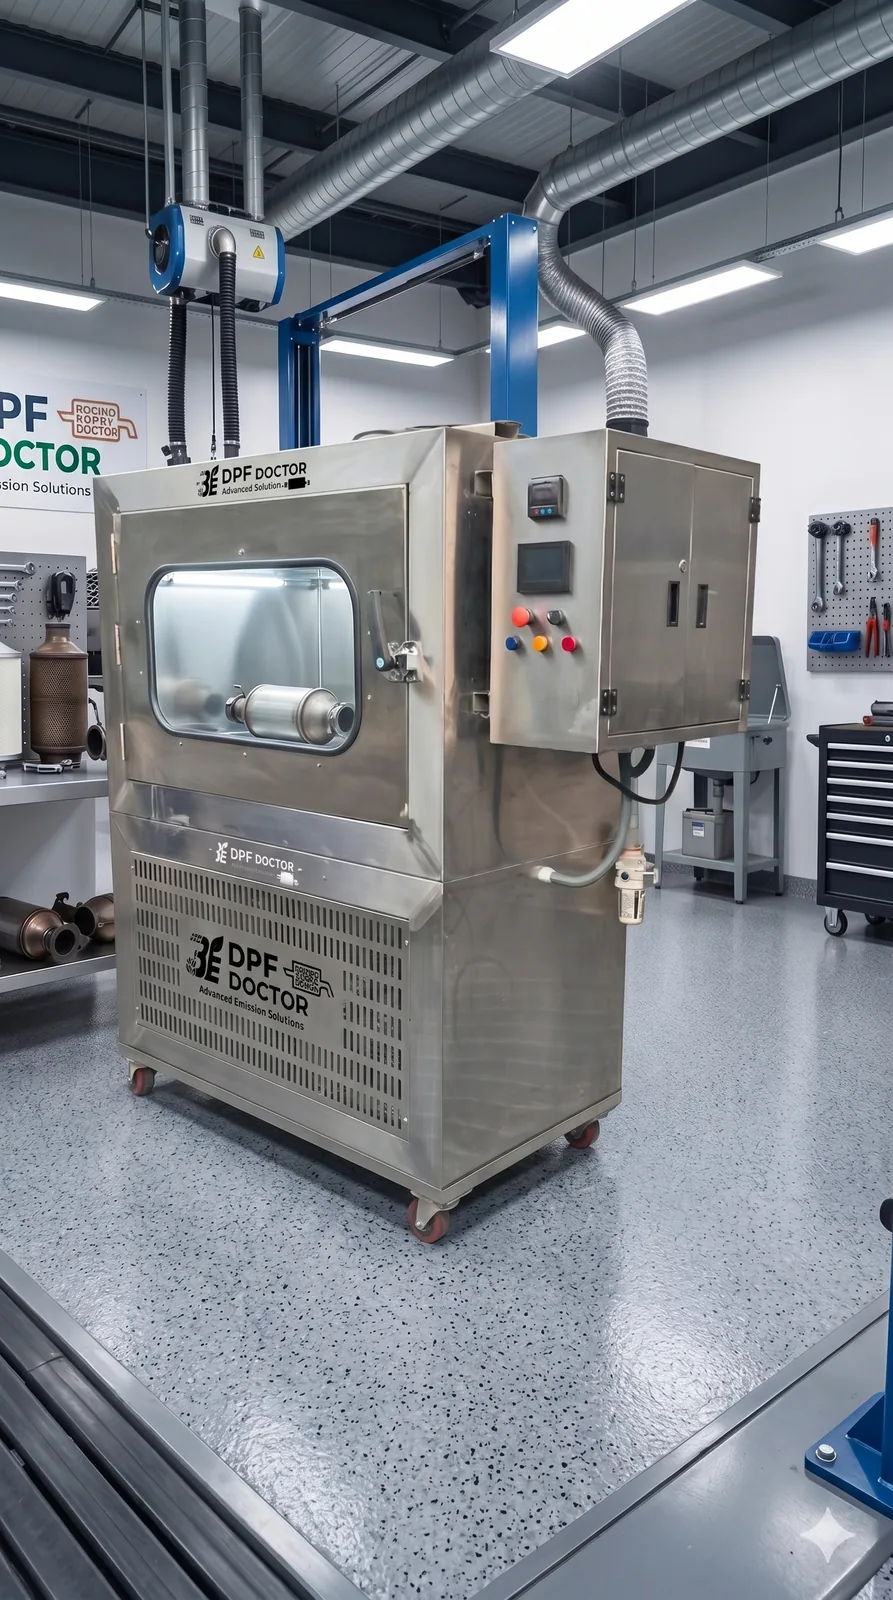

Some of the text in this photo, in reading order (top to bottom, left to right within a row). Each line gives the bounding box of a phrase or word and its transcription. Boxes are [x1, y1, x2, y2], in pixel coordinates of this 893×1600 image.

[0, 392, 48, 432] PF
[76, 424, 118, 437] DOCTOR
[222, 465, 252, 484] DPF
[255, 462, 307, 480] DOCTOR
[33, 481, 91, 497] Solutions
[222, 484, 253, 495] Advanced
[230, 847, 253, 863] DPF
[255, 854, 294, 871] DOCTOR
[228, 941, 278, 978] DPF
[229, 971, 309, 1016] DOCTOR
[199, 985, 305, 1031] Advanced Emission Solutions
